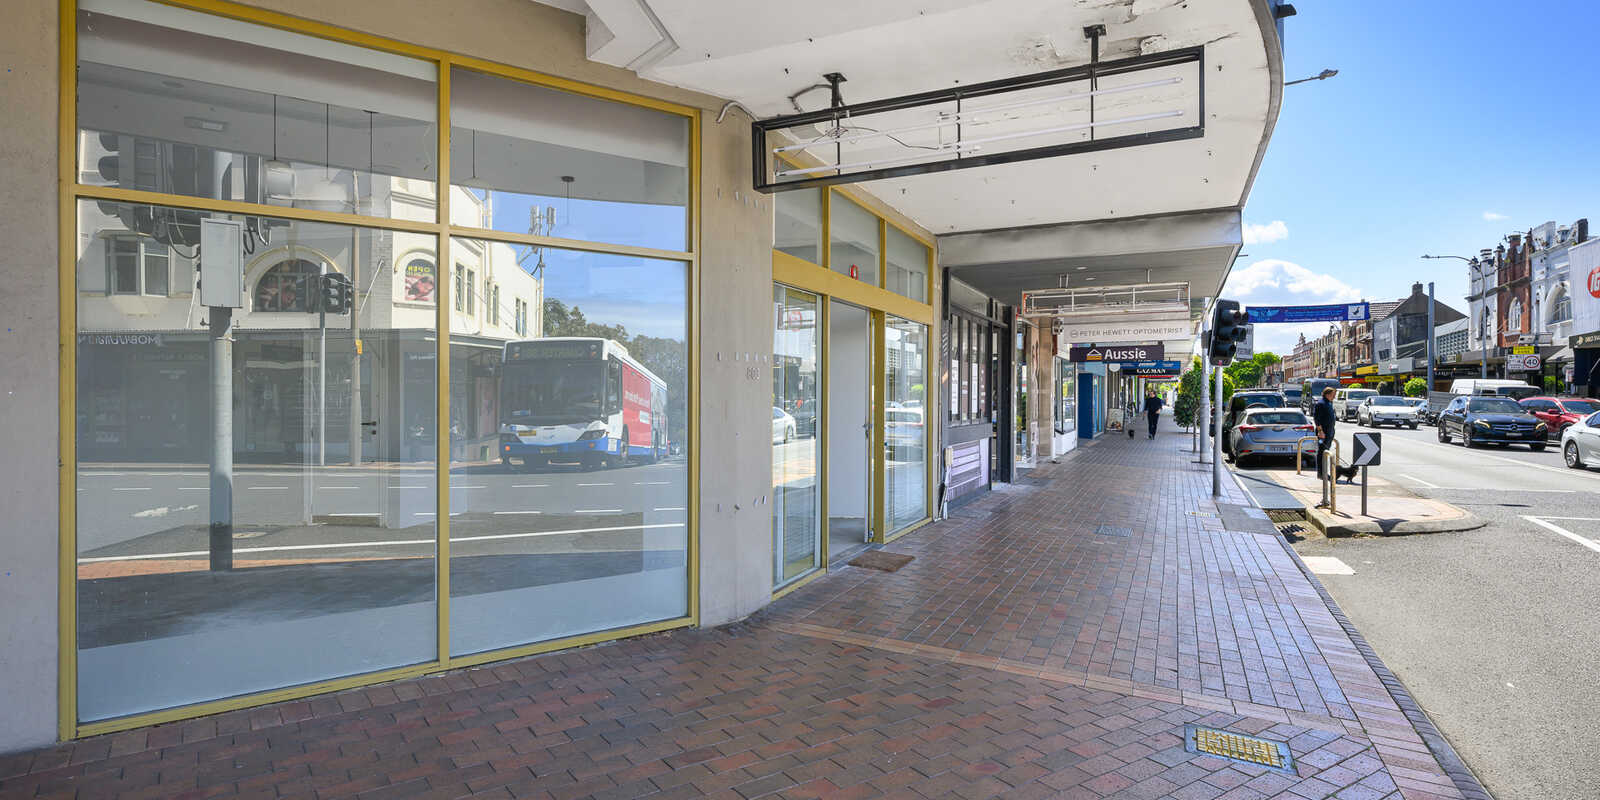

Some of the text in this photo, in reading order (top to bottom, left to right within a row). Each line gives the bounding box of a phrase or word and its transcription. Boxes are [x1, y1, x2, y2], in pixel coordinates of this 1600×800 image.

[1079, 330, 1101, 338] PETER
[1133, 327, 1183, 336] OPTOMETRIST
[1104, 348, 1147, 360] Aussie
[1526, 358, 1538, 366] 40
